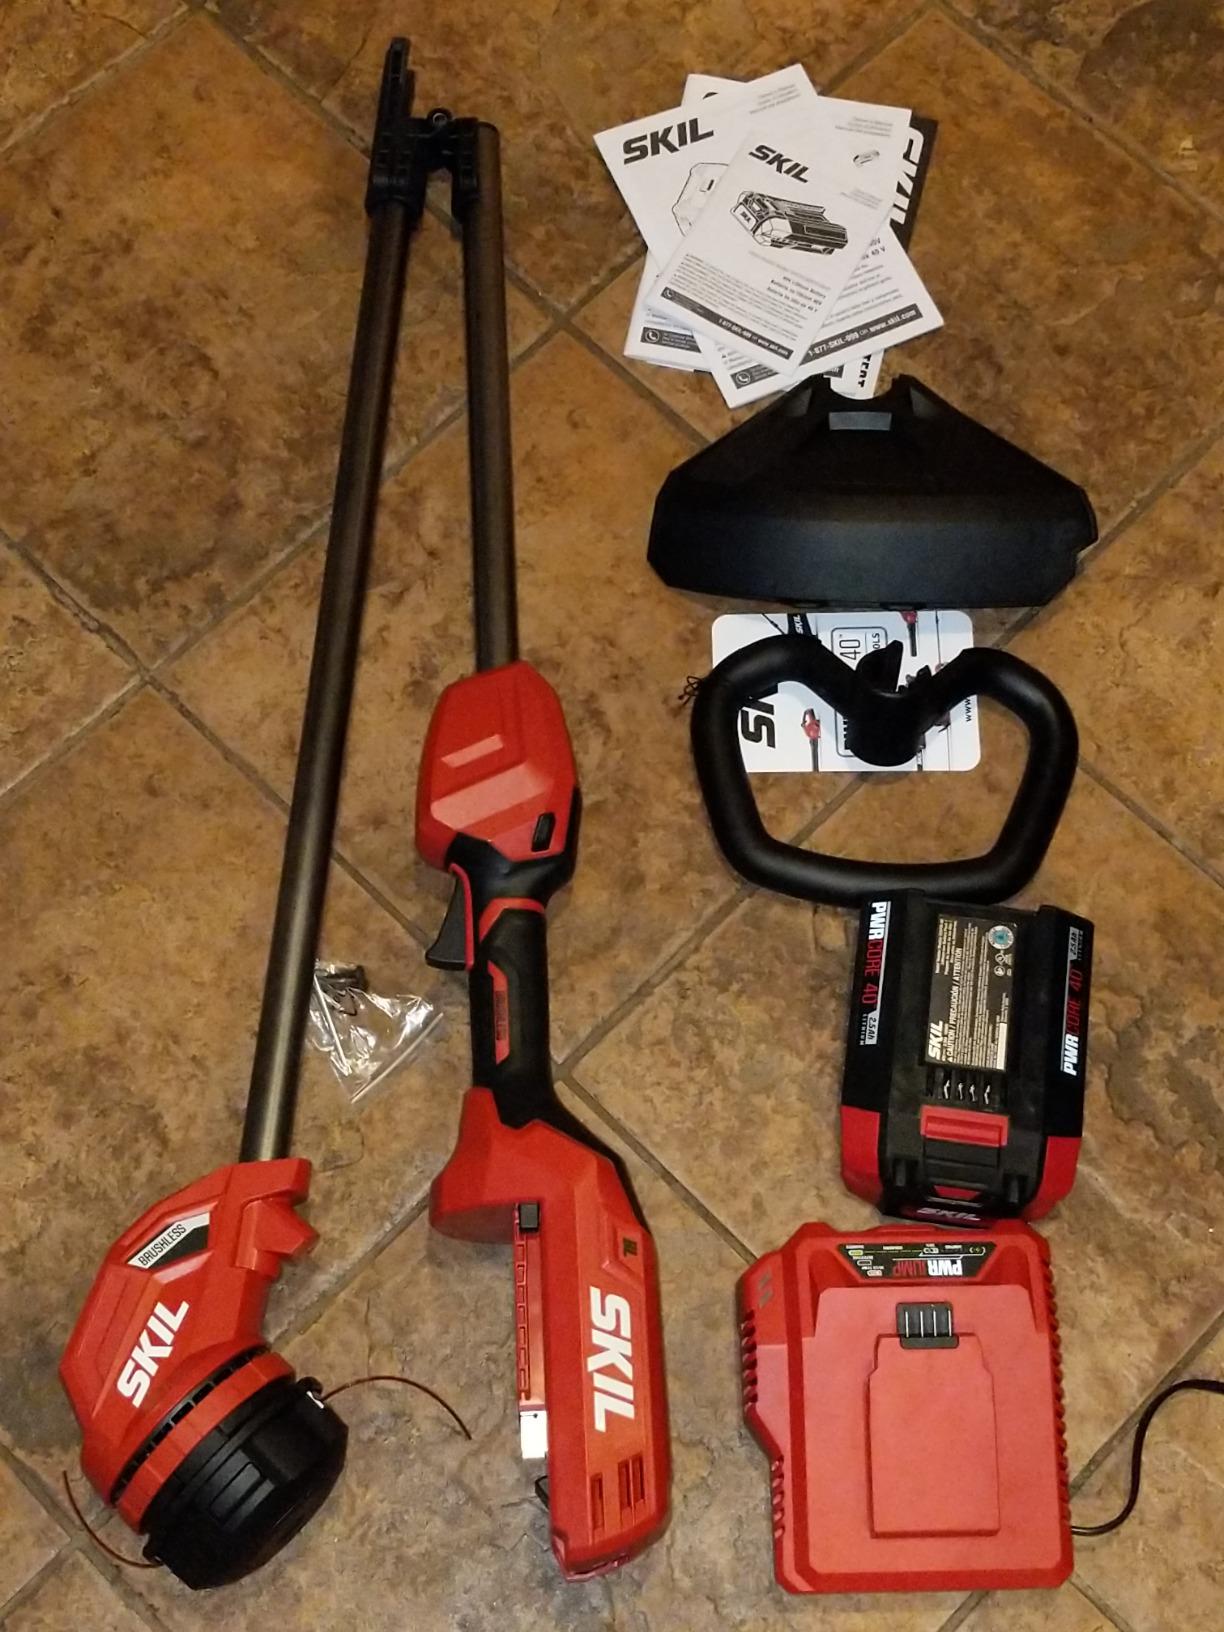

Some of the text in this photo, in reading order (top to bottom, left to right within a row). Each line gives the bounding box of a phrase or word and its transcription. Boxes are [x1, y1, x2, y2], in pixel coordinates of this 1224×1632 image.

[623, 117, 714, 165] SKIL
[748, 145, 809, 183] SKIL
[869, 309, 917, 332] www.skil.com
[793, 614, 804, 635] SKIL
[839, 639, 861, 661] 40
[862, 983, 878, 1004] 40
[859, 1013, 868, 1046] LITHIUM
[928, 1020, 944, 1060] SKIL
[946, 1029, 956, 1057] CAUTION
[138, 1223, 187, 1267] BRUSHLESS
[117, 1300, 190, 1409] SKIL
[587, 1286, 635, 1433] SKIL
